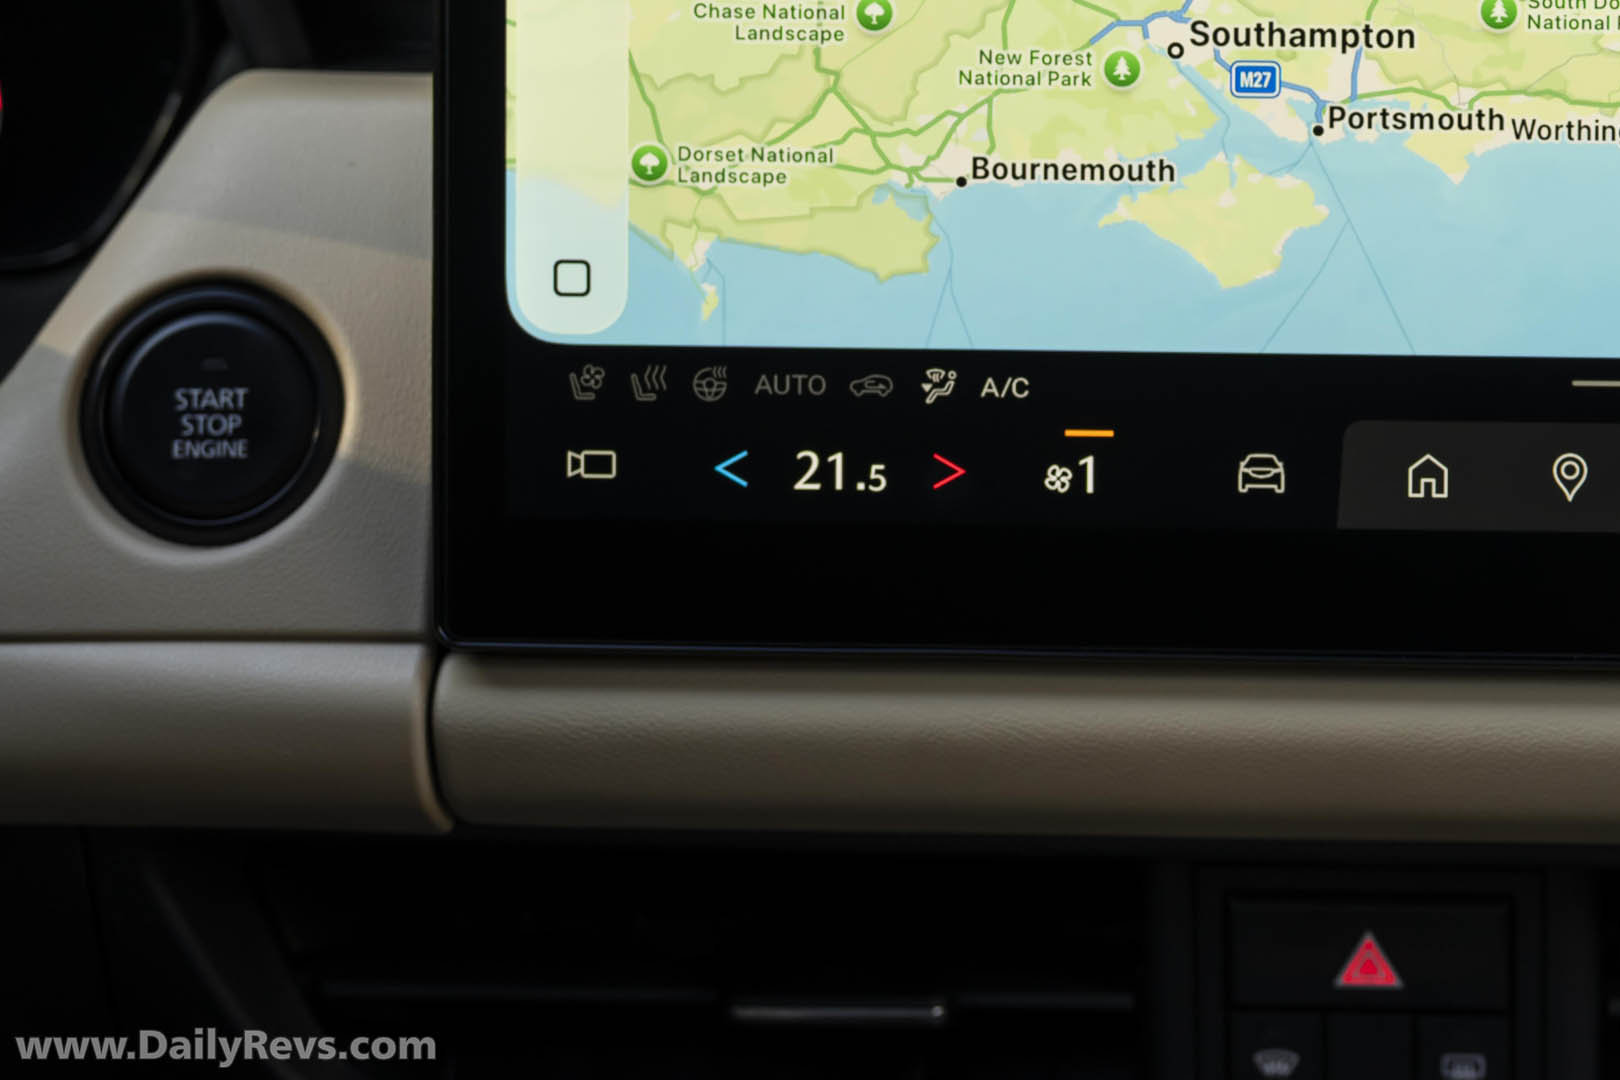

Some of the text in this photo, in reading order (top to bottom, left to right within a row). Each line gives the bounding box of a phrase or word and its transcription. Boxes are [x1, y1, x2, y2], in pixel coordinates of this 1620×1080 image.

[693, 3, 845, 20] Chase National
[1527, 14, 1610, 31] National
[735, 25, 844, 44] Landscape
[1190, 20, 1415, 55] Southampton
[979, 49, 1092, 66] New Forest
[959, 70, 1091, 86] National Park
[1240, 72, 1271, 89] M27
[1329, 105, 1504, 131] Portsmouth
[678, 146, 833, 163] Dorset National
[678, 167, 787, 187] Landscape
[972, 156, 1175, 182] Bournemouth
[755, 375, 826, 395] AUTO
[981, 377, 1029, 398] A/C
[175, 388, 248, 410] START
[182, 414, 242, 436] STOP
[172, 440, 248, 459] ENGINE
[1079, 455, 1094, 493] 1
